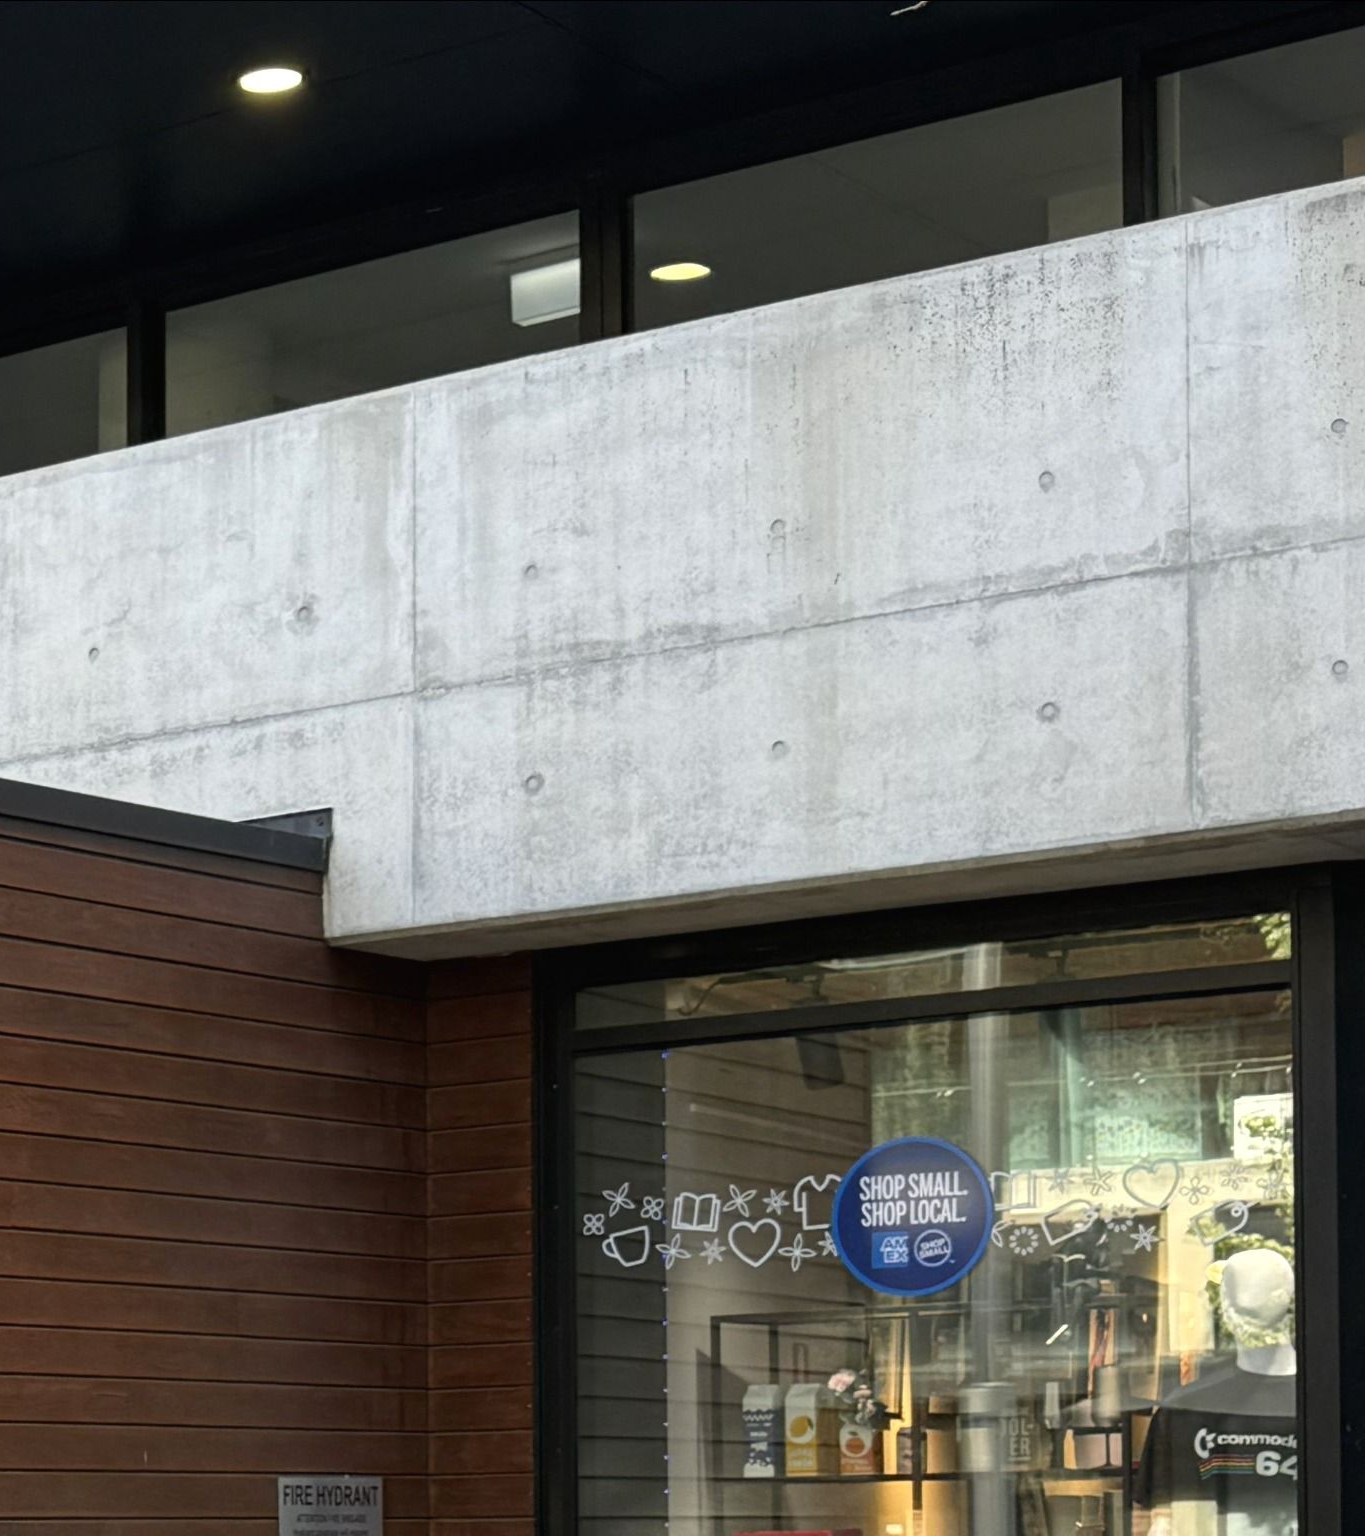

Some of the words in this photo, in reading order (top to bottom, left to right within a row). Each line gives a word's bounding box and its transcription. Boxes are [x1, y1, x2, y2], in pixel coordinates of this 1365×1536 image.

[859, 1174, 906, 1201] SHOP
[907, 1170, 969, 1199] SMALL.
[860, 1200, 907, 1227] SHOP
[909, 1197, 967, 1225] LOCAL.
[883, 1250, 909, 1263] EX
[1255, 1450, 1298, 1480] 64
[283, 1484, 314, 1506] FIRE
[316, 1484, 379, 1507] HYDRANT
